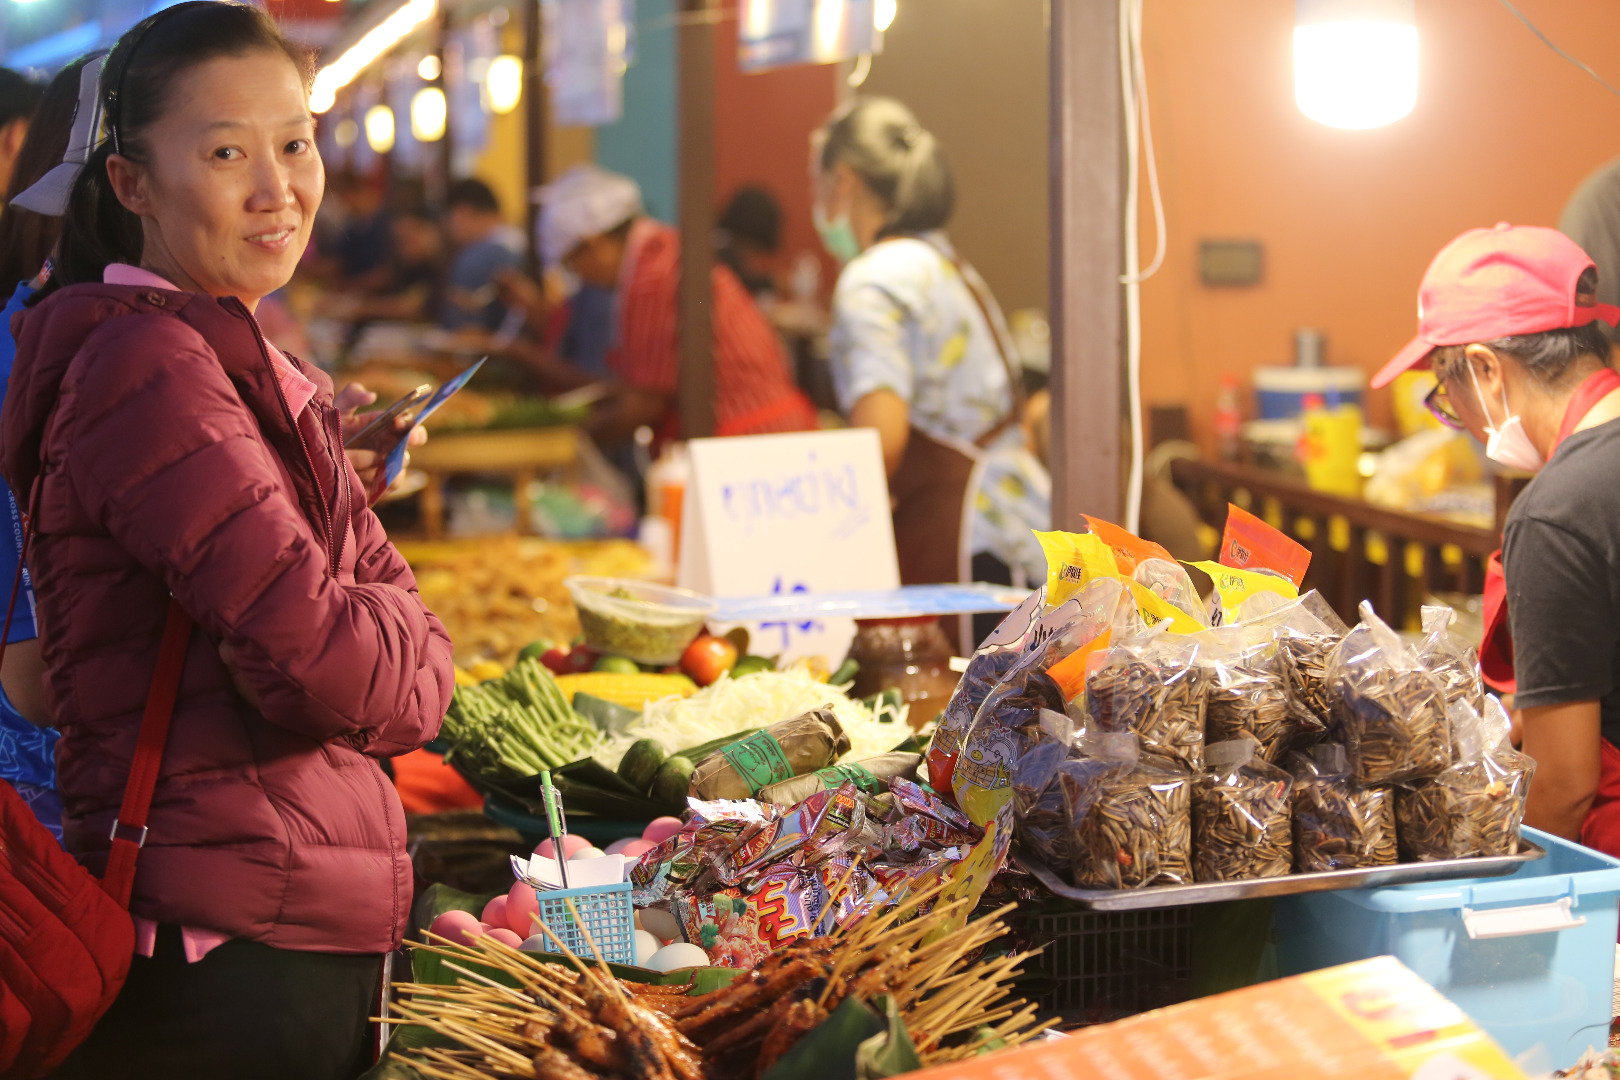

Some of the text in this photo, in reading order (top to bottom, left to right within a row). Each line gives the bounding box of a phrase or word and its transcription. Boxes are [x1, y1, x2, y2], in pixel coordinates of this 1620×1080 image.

[8, 489, 31, 587] CROSS COUNT RUN
